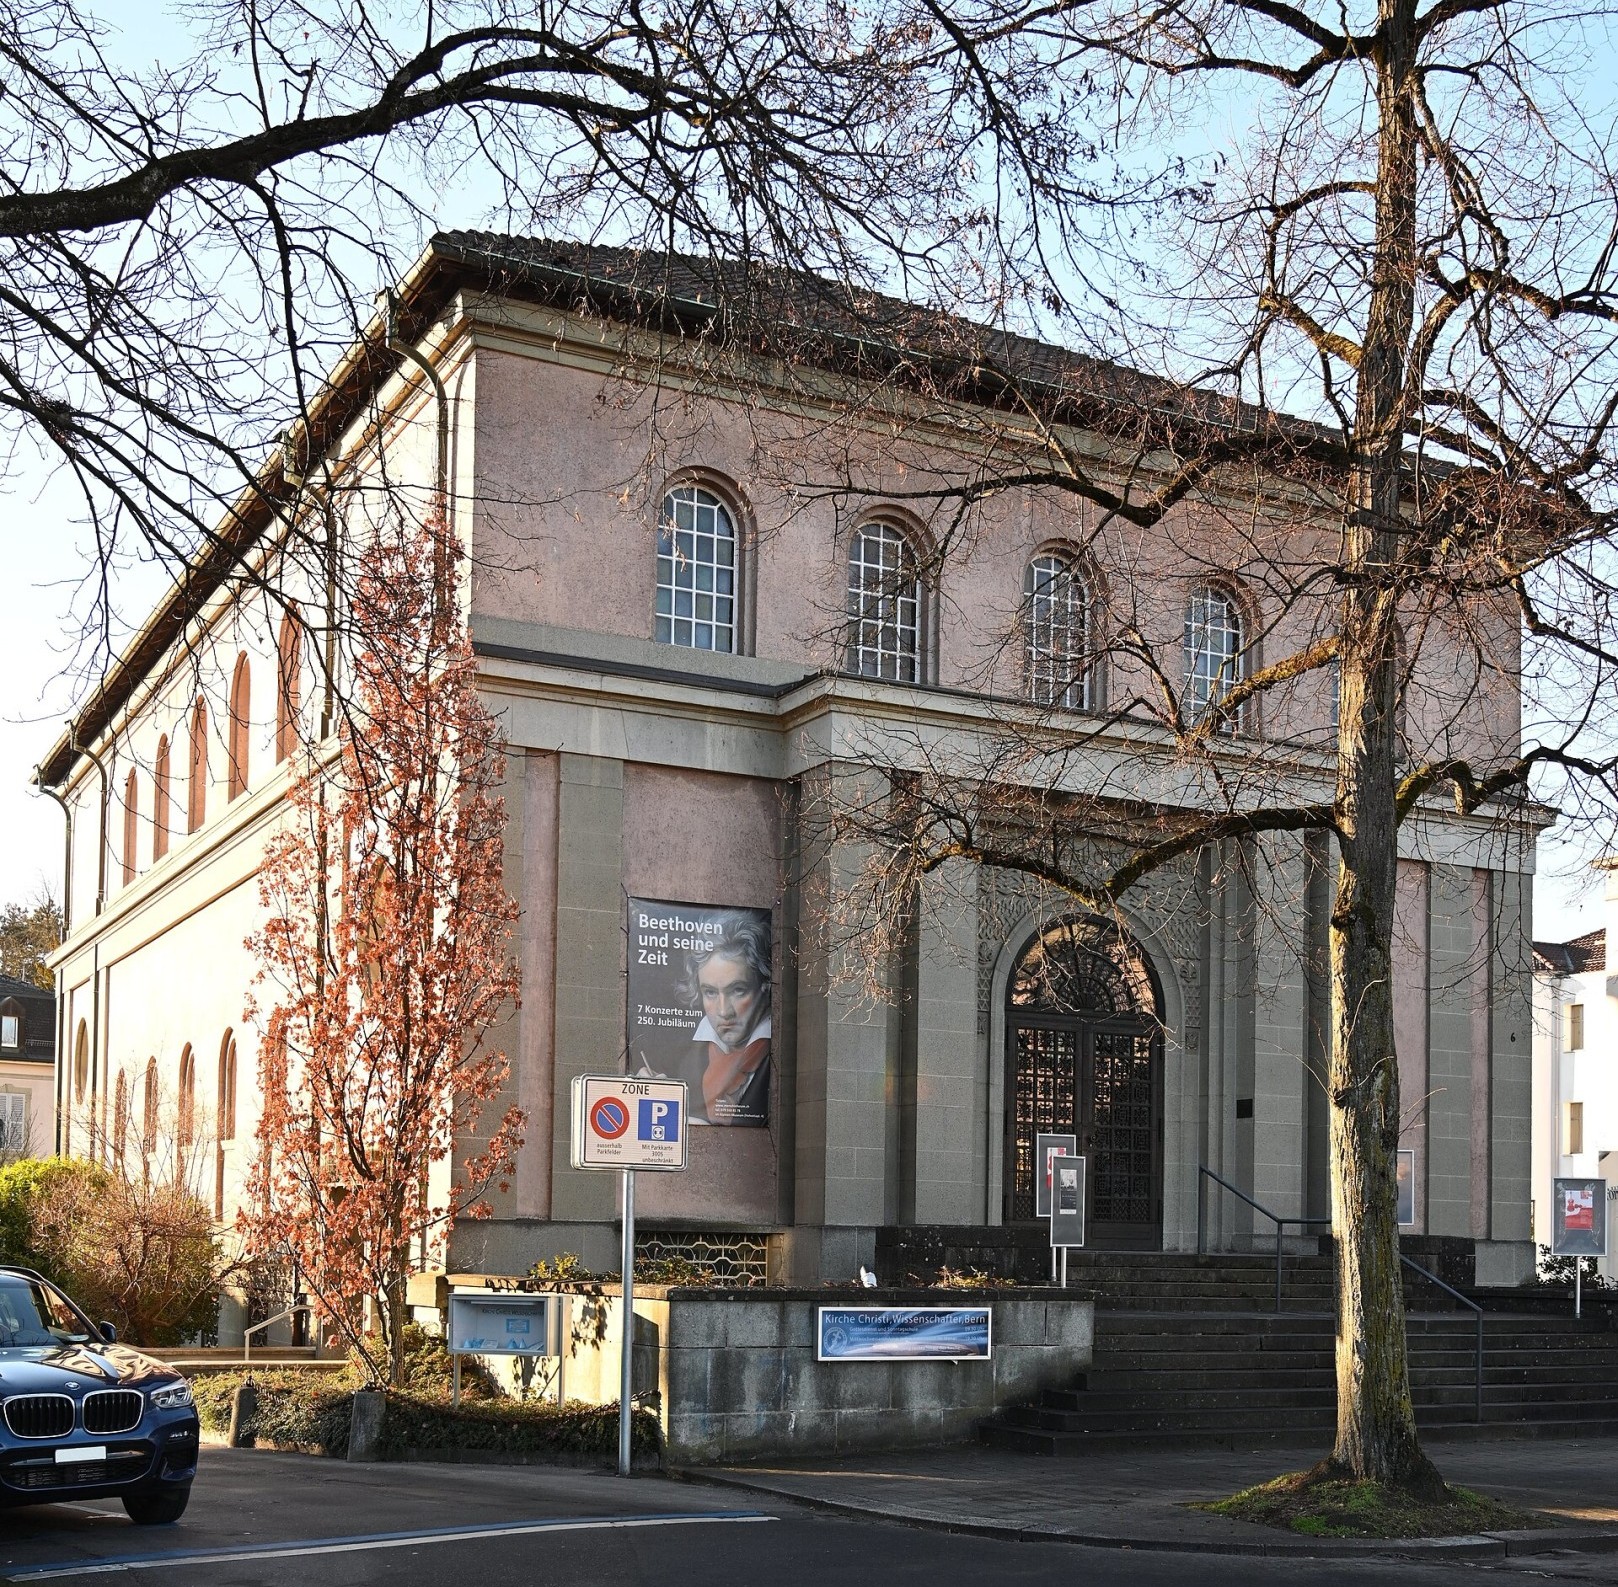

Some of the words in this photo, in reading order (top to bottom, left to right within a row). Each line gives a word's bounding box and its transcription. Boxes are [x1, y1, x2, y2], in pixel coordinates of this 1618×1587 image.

[639, 914, 723, 934] Beethoven
[638, 932, 669, 948] und
[673, 935, 714, 952] seine
[638, 949, 668, 966] Zeit
[637, 1004, 643, 1013] 7
[645, 1004, 683, 1016] Konzerte
[684, 1009, 703, 1018] zum
[637, 1016, 656, 1026] 250.
[657, 1017, 696, 1029] Jubiläum
[1510, 1032, 1516, 1043] 6
[622, 1084, 650, 1095] ZONE
[651, 1102, 668, 1124] P
[825, 1313, 856, 1324] Kirche
